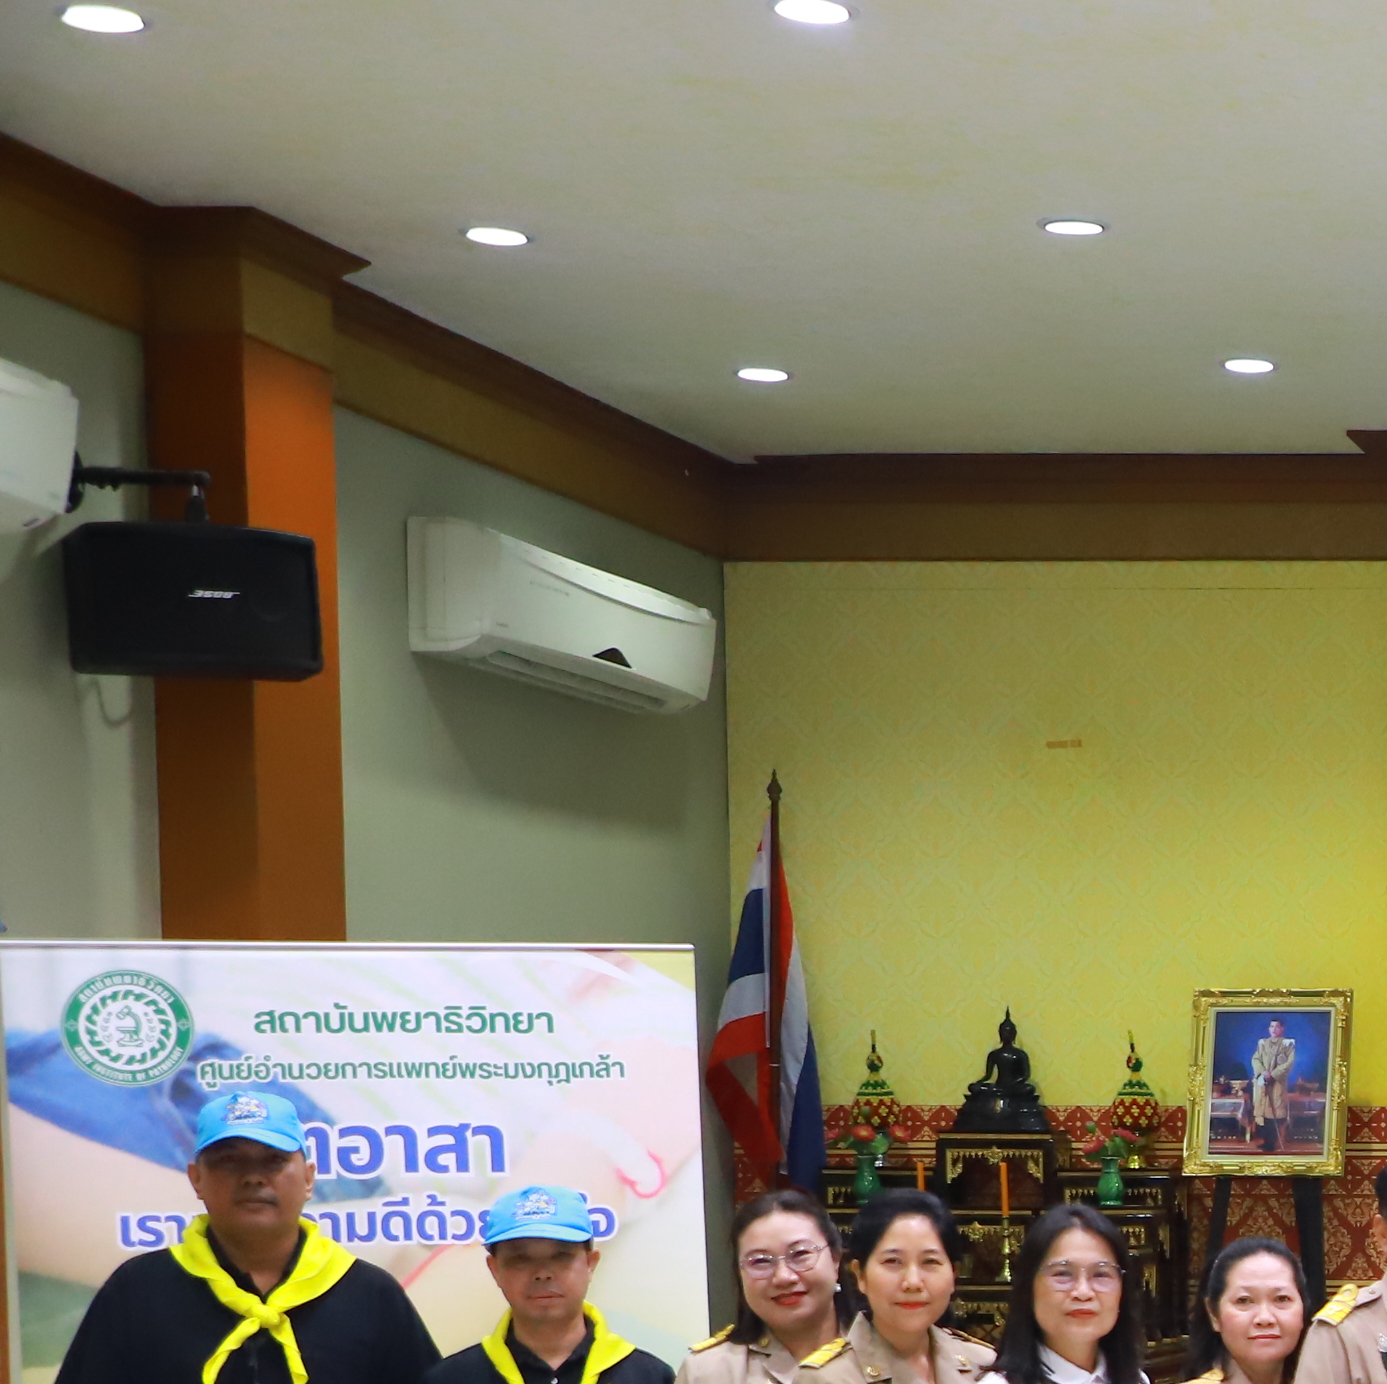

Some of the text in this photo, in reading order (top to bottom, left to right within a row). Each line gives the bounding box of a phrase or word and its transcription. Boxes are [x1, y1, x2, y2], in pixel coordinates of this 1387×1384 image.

[254, 1003, 555, 1035] สถาบันพยาธิวิทยา
[199, 1055, 626, 1089] ศูนย์อำนวยการแพทย์พระมงกุฎเกล้า
